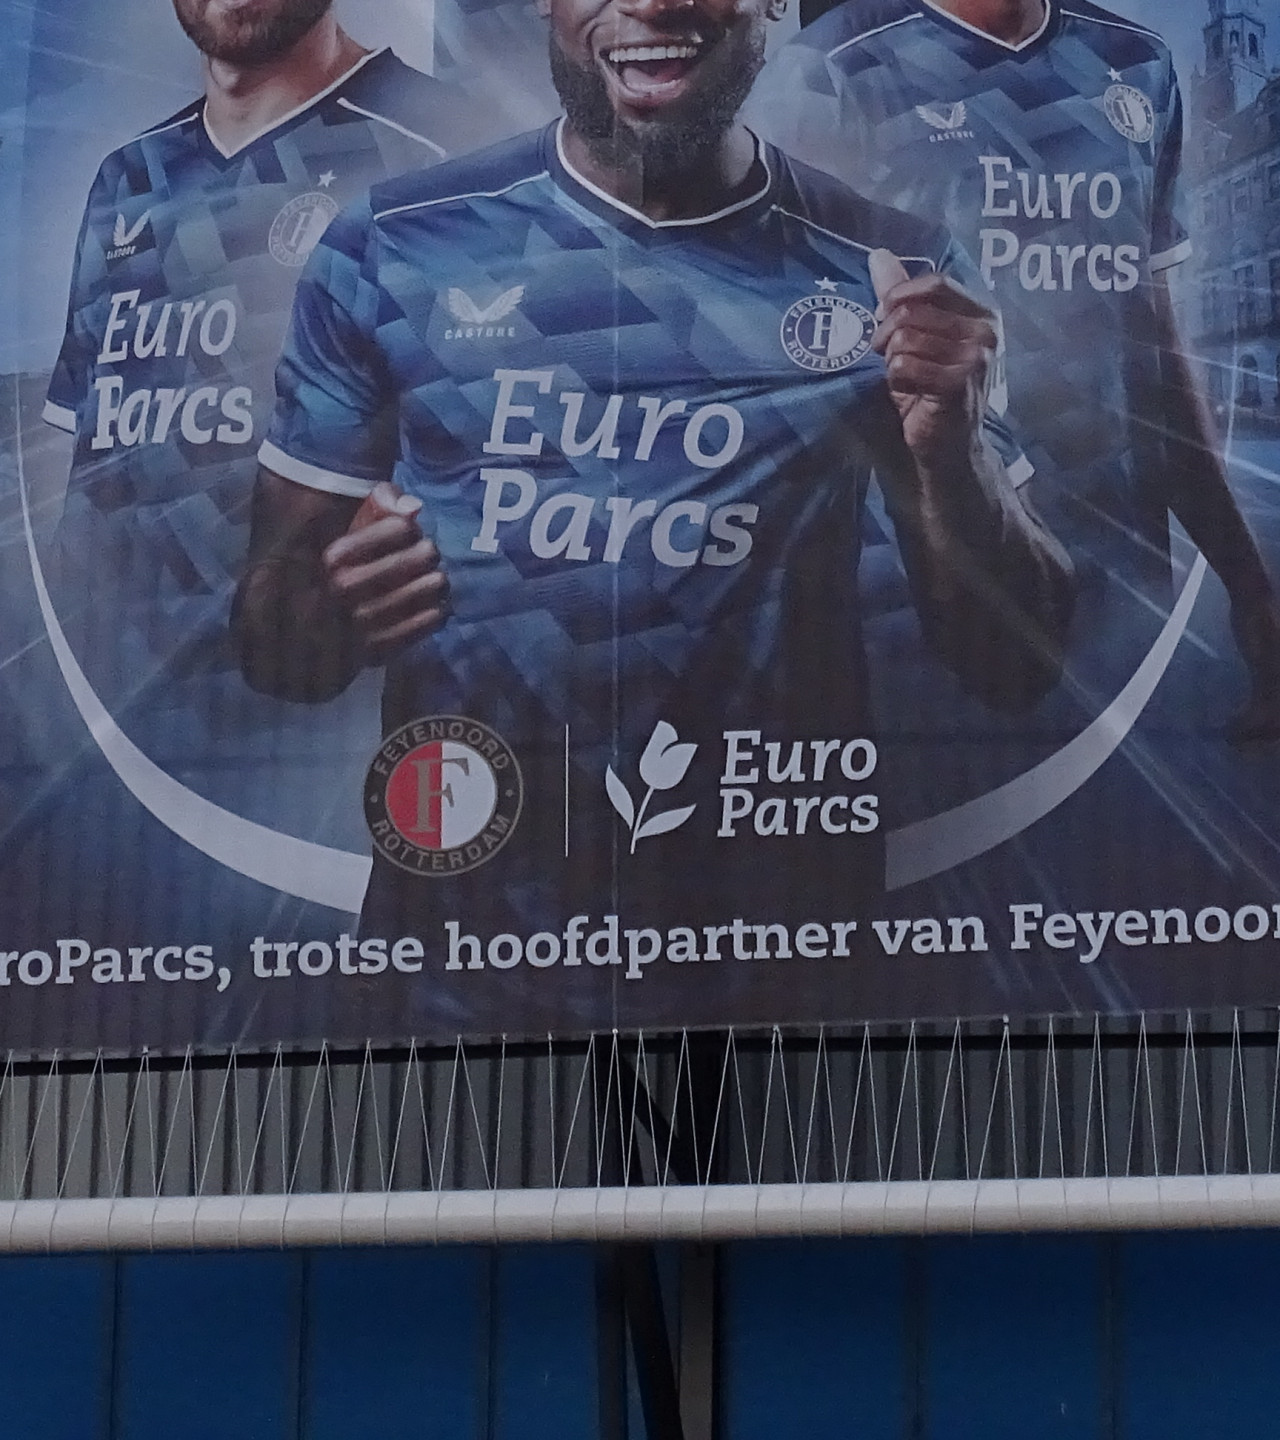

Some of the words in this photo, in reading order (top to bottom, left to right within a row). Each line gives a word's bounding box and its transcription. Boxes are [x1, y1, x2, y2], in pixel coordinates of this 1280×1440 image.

[978, 155, 1122, 220] Euro
[978, 228, 1140, 292] Parcs
[96, 288, 237, 365] Euro
[444, 326, 516, 340] CASTORE
[91, 374, 254, 451] Parcs
[482, 368, 745, 469] Euro
[470, 467, 759, 568] Parcs
[373, 721, 510, 777] FEYENOORD
[720, 730, 878, 784] Euro
[409, 757, 471, 834] F
[717, 788, 880, 838] Parcs
[372, 812, 511, 871] ROTTERDAM
[250, 933, 426, 978] trotse
[444, 914, 857, 979] hoofdpartner
[872, 915, 988, 955] van
